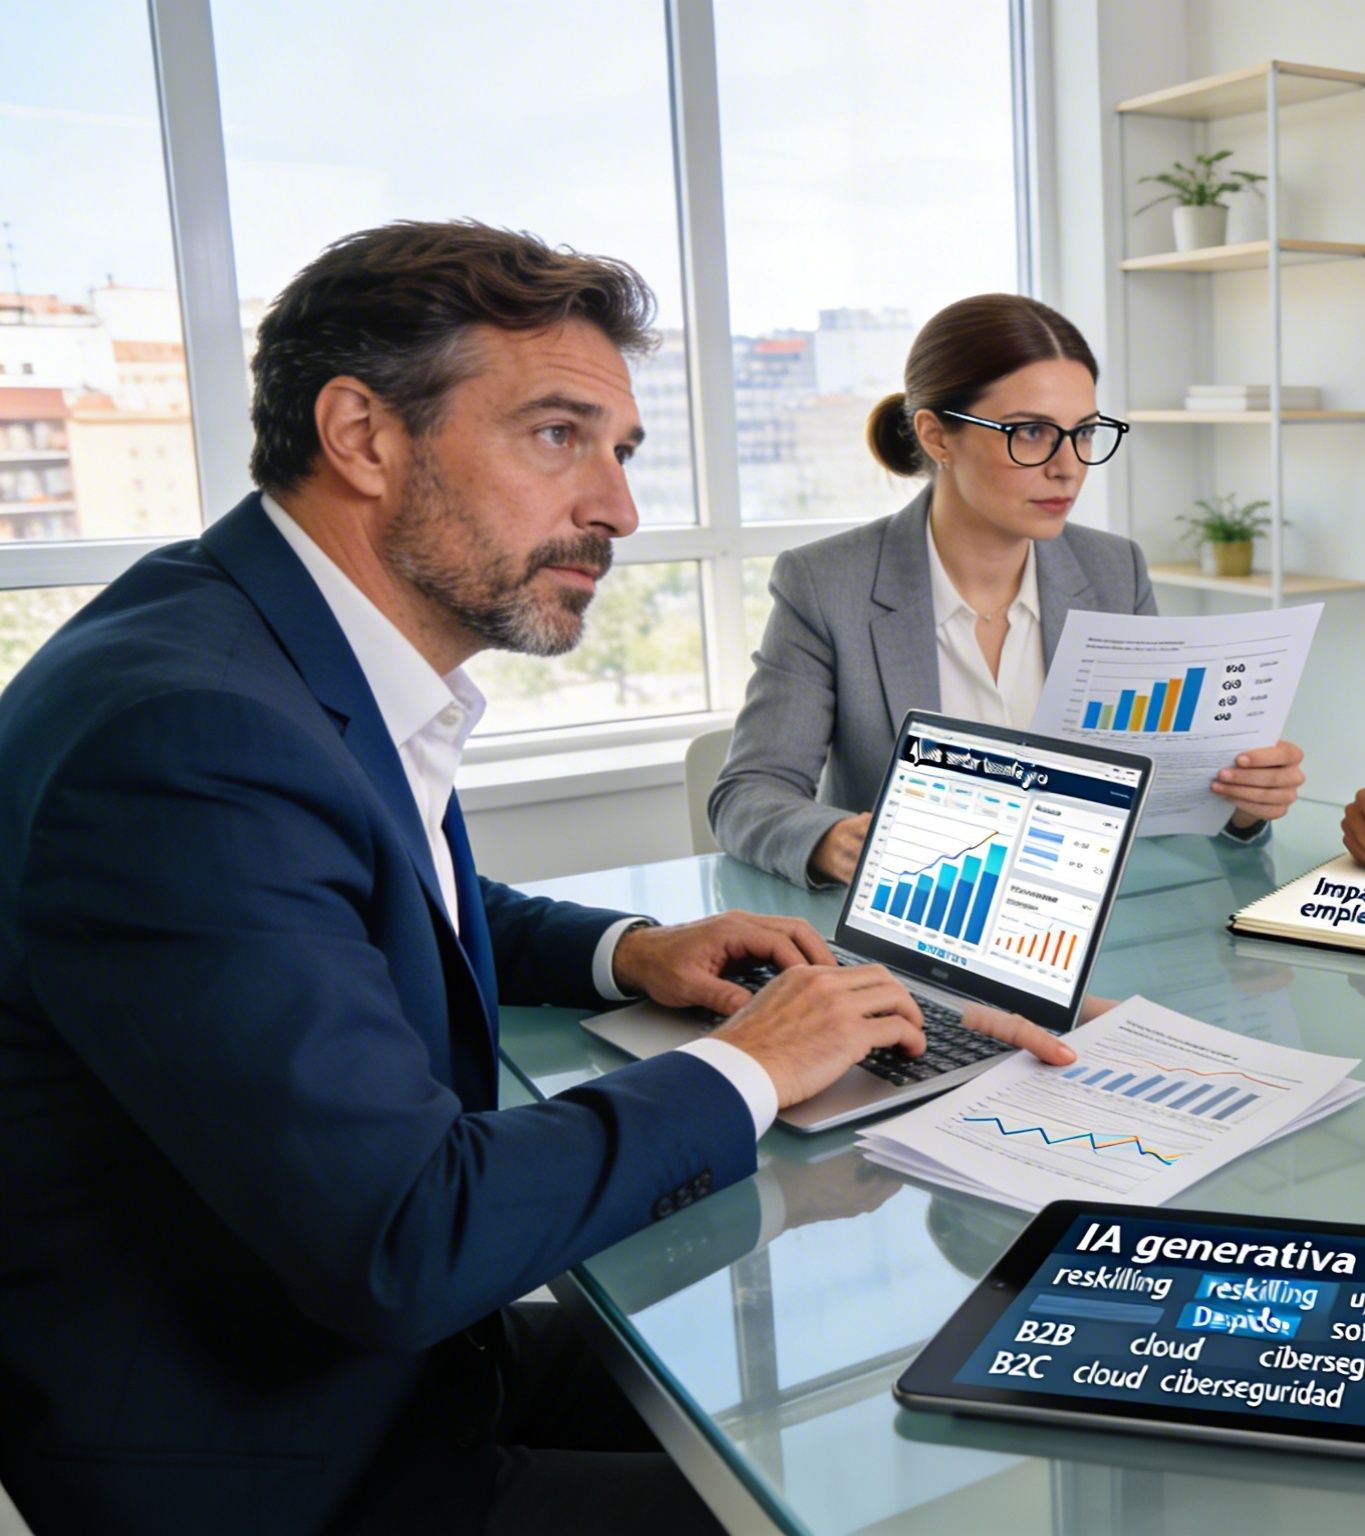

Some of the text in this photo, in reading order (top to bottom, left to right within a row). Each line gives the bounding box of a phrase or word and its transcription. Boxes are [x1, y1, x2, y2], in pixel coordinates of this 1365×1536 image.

[1076, 1223, 1357, 1275] IA generativa
[1014, 1320, 1076, 1346] B2B
[1130, 1332, 1206, 1361] cloud
[988, 1351, 1052, 1379] B2C
[1073, 1360, 1149, 1389] cloud
[1160, 1368, 1346, 1408] ciberseguridad
